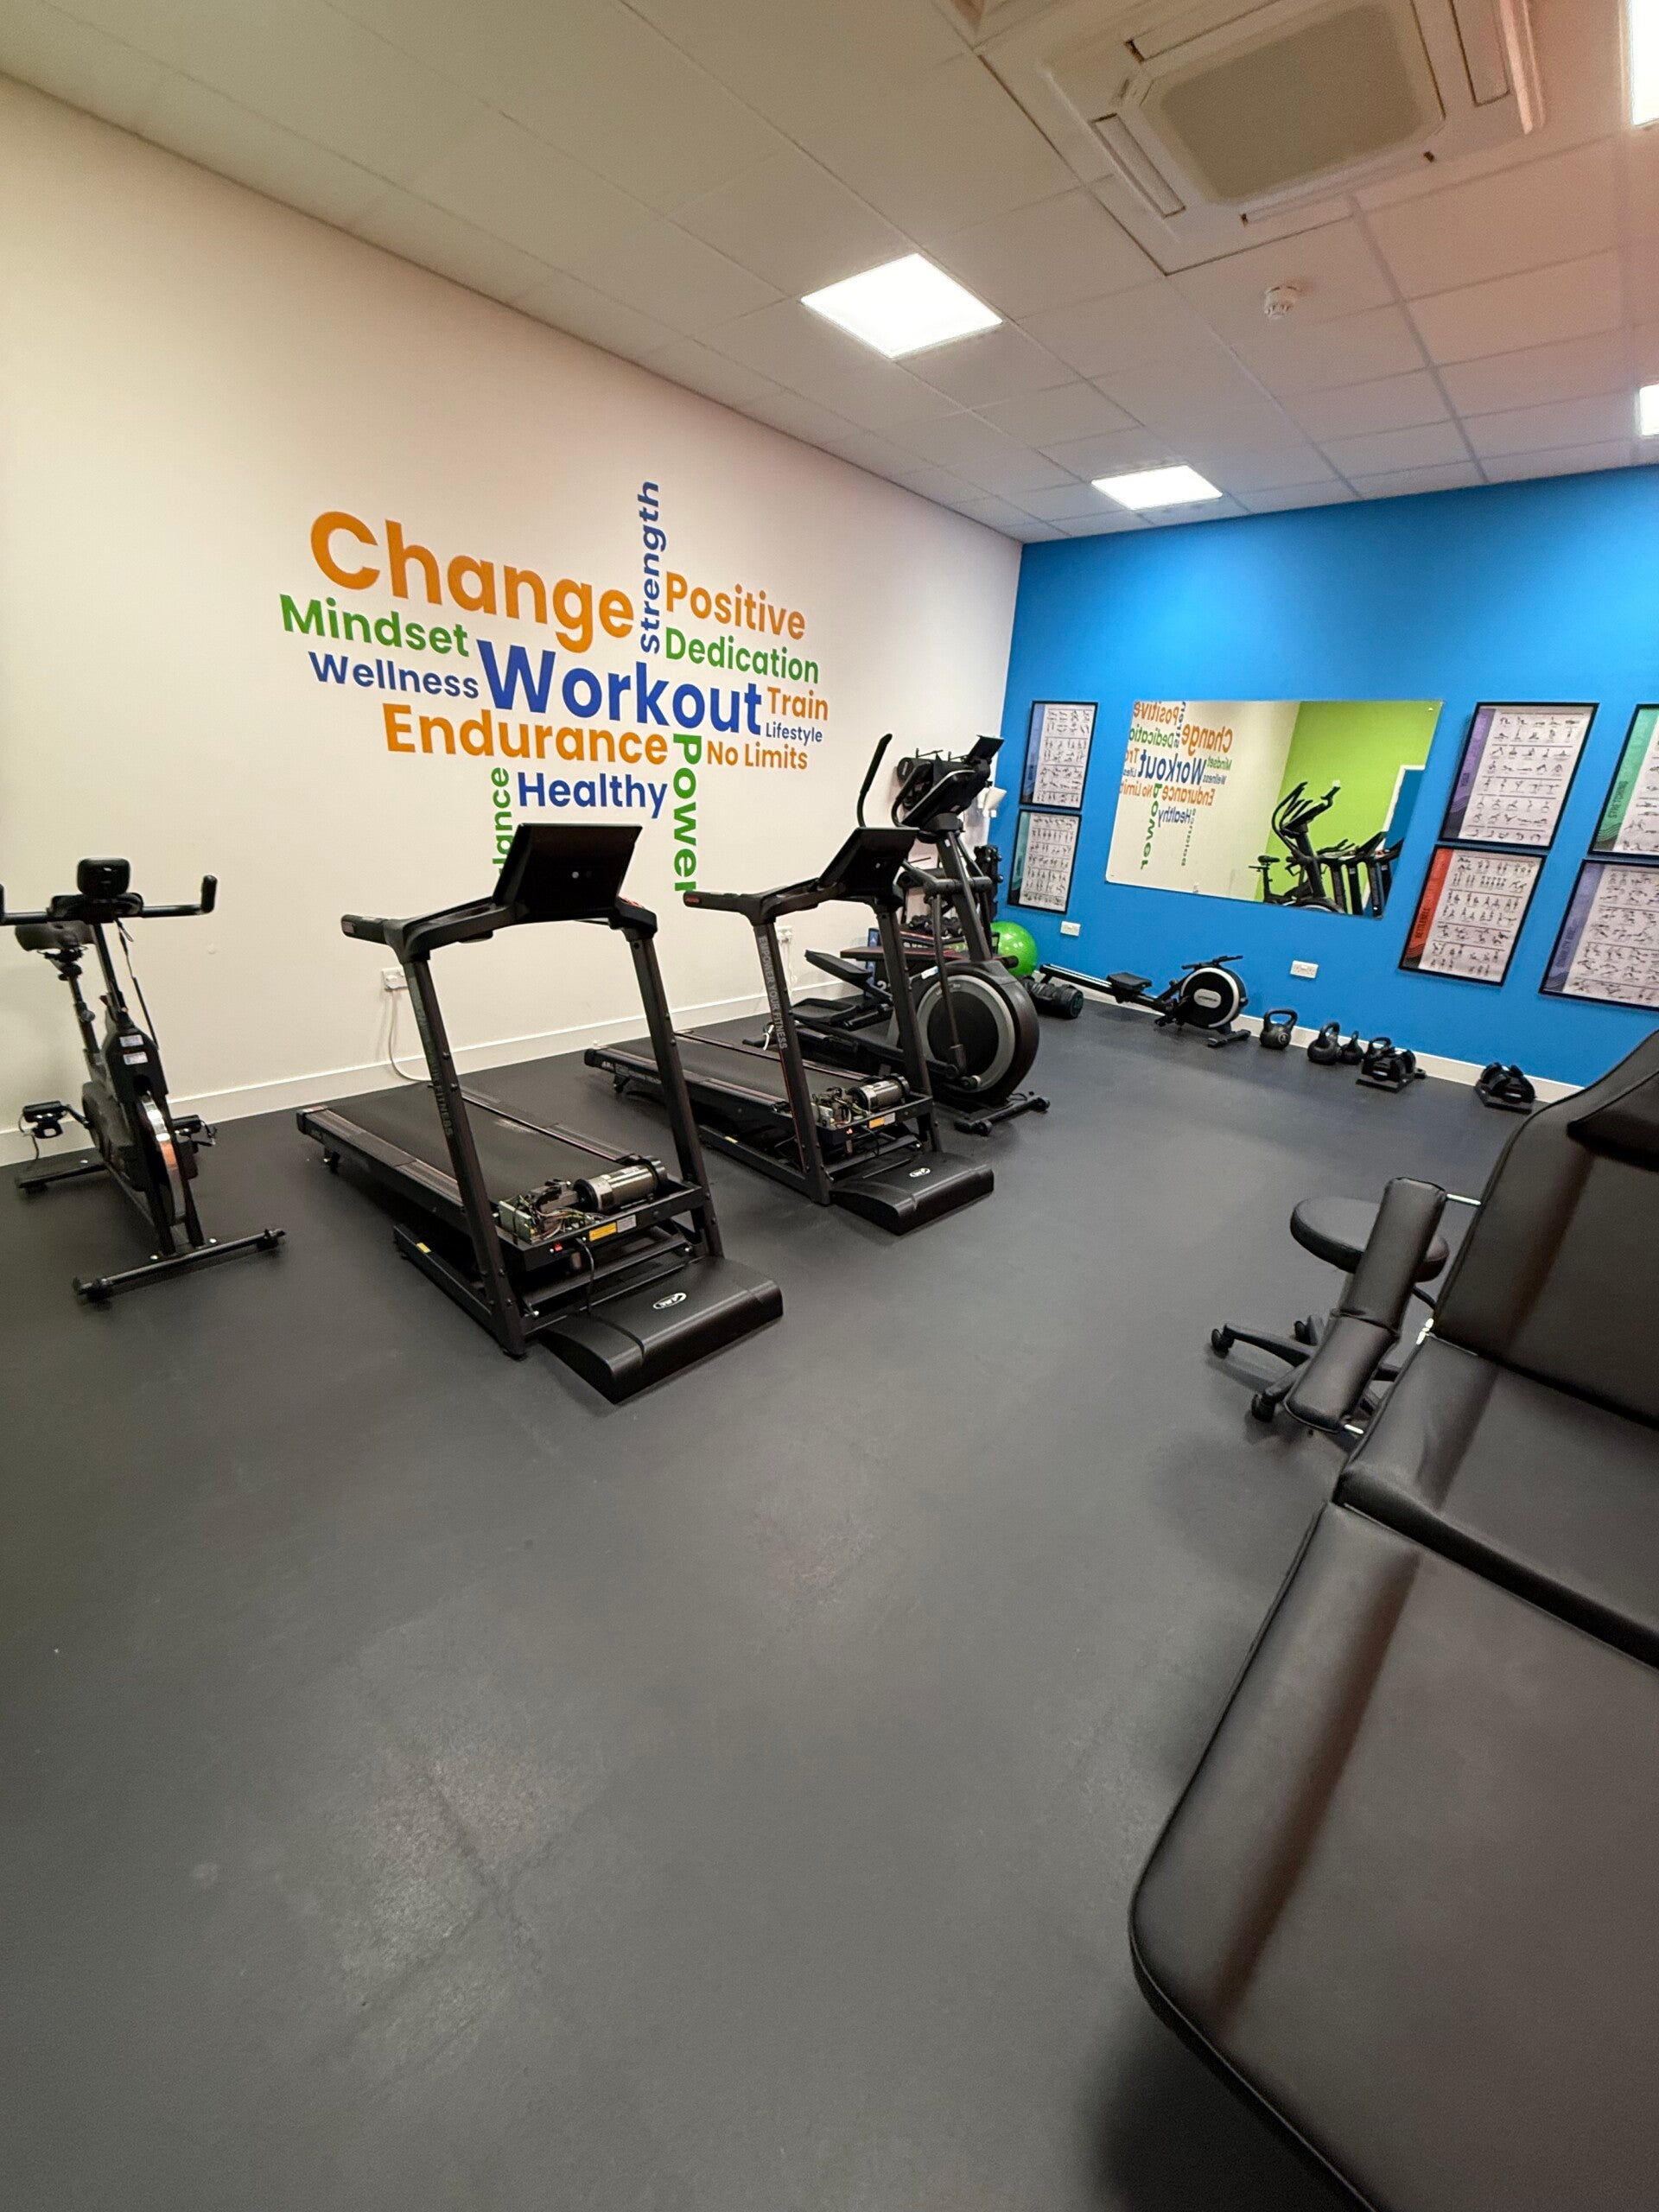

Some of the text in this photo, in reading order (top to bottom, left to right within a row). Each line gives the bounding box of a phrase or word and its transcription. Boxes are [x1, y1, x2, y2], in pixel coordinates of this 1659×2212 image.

[309, 511, 634, 653] Change
[639, 480, 666, 653] Strength
[279, 594, 469, 657] Mindset
[665, 571, 806, 640] Positive
[308, 652, 479, 698] Wellness
[665, 627, 819, 683] Dedication
[476, 640, 761, 735] Workout
[766, 686, 829, 721] Train
[382, 702, 668, 766] Endurance
[707, 741, 808, 770] No Limits
[765, 723, 823, 743] Lifestyle
[518, 772, 668, 818] Healthy
[759, 936, 788, 1050] EMPOWER YOUR FITNESS
